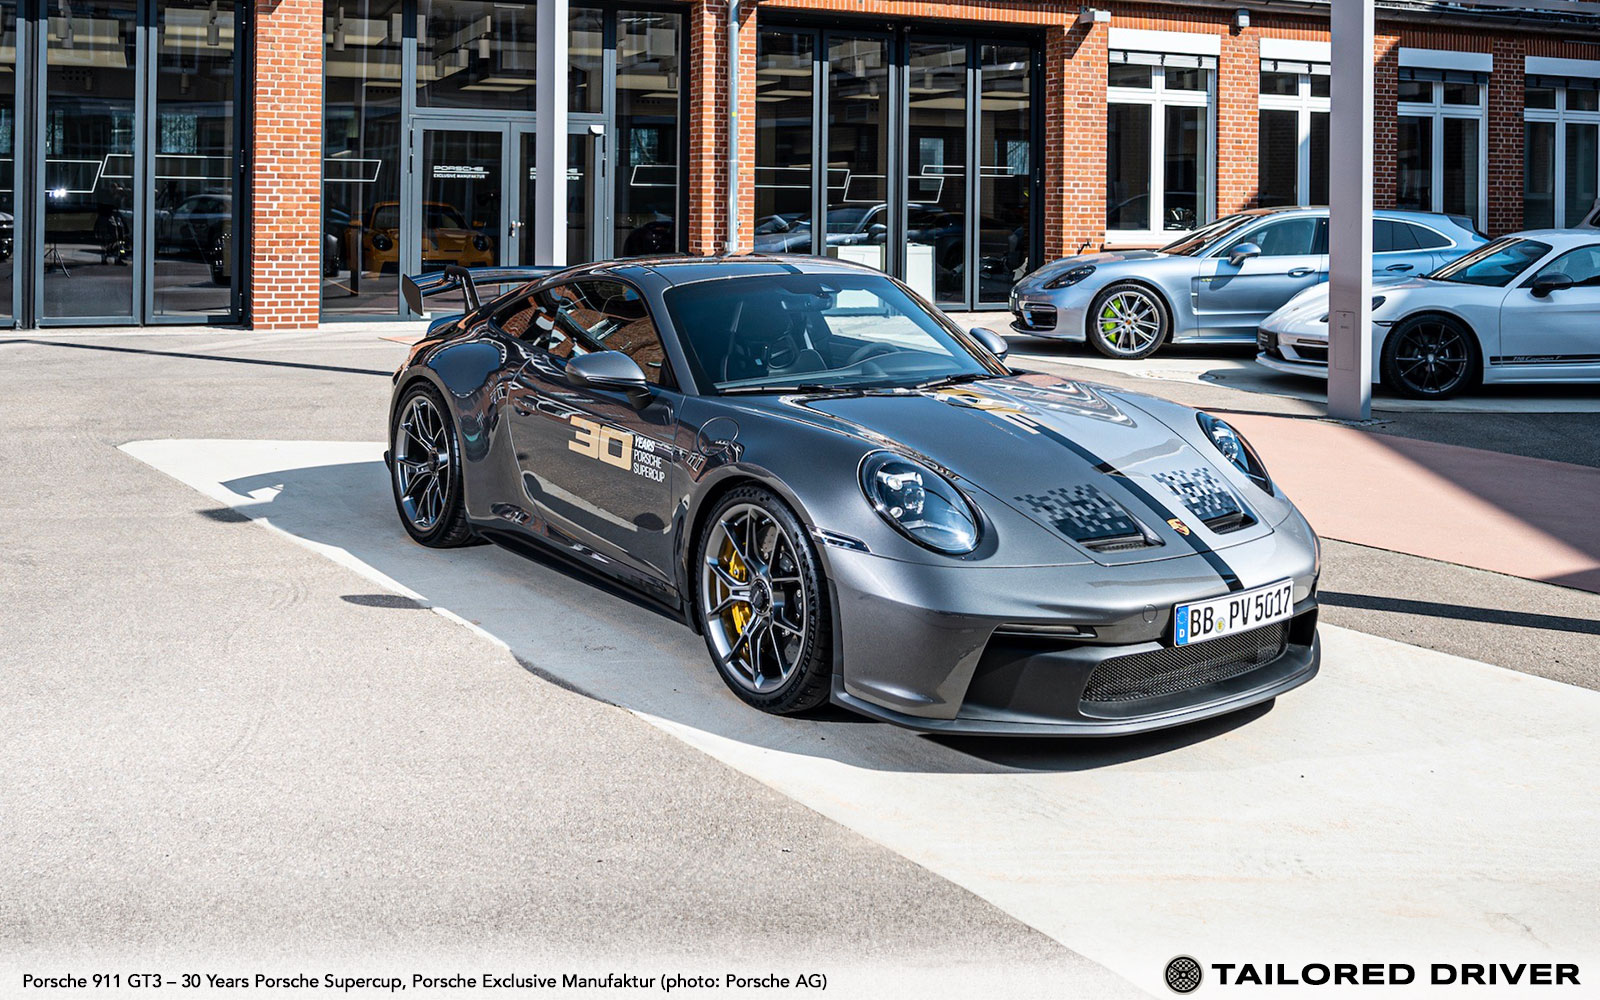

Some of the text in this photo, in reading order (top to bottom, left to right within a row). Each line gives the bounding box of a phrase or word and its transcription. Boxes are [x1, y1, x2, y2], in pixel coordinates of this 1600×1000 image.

[568, 415, 634, 471] 30
[634, 435, 656, 452] YEARS
[633, 450, 662, 468] PORSCHE
[633, 463, 665, 483] SUPERCUP
[1190, 585, 1291, 638] BB PV 5017
[1179, 628, 1185, 638] D
